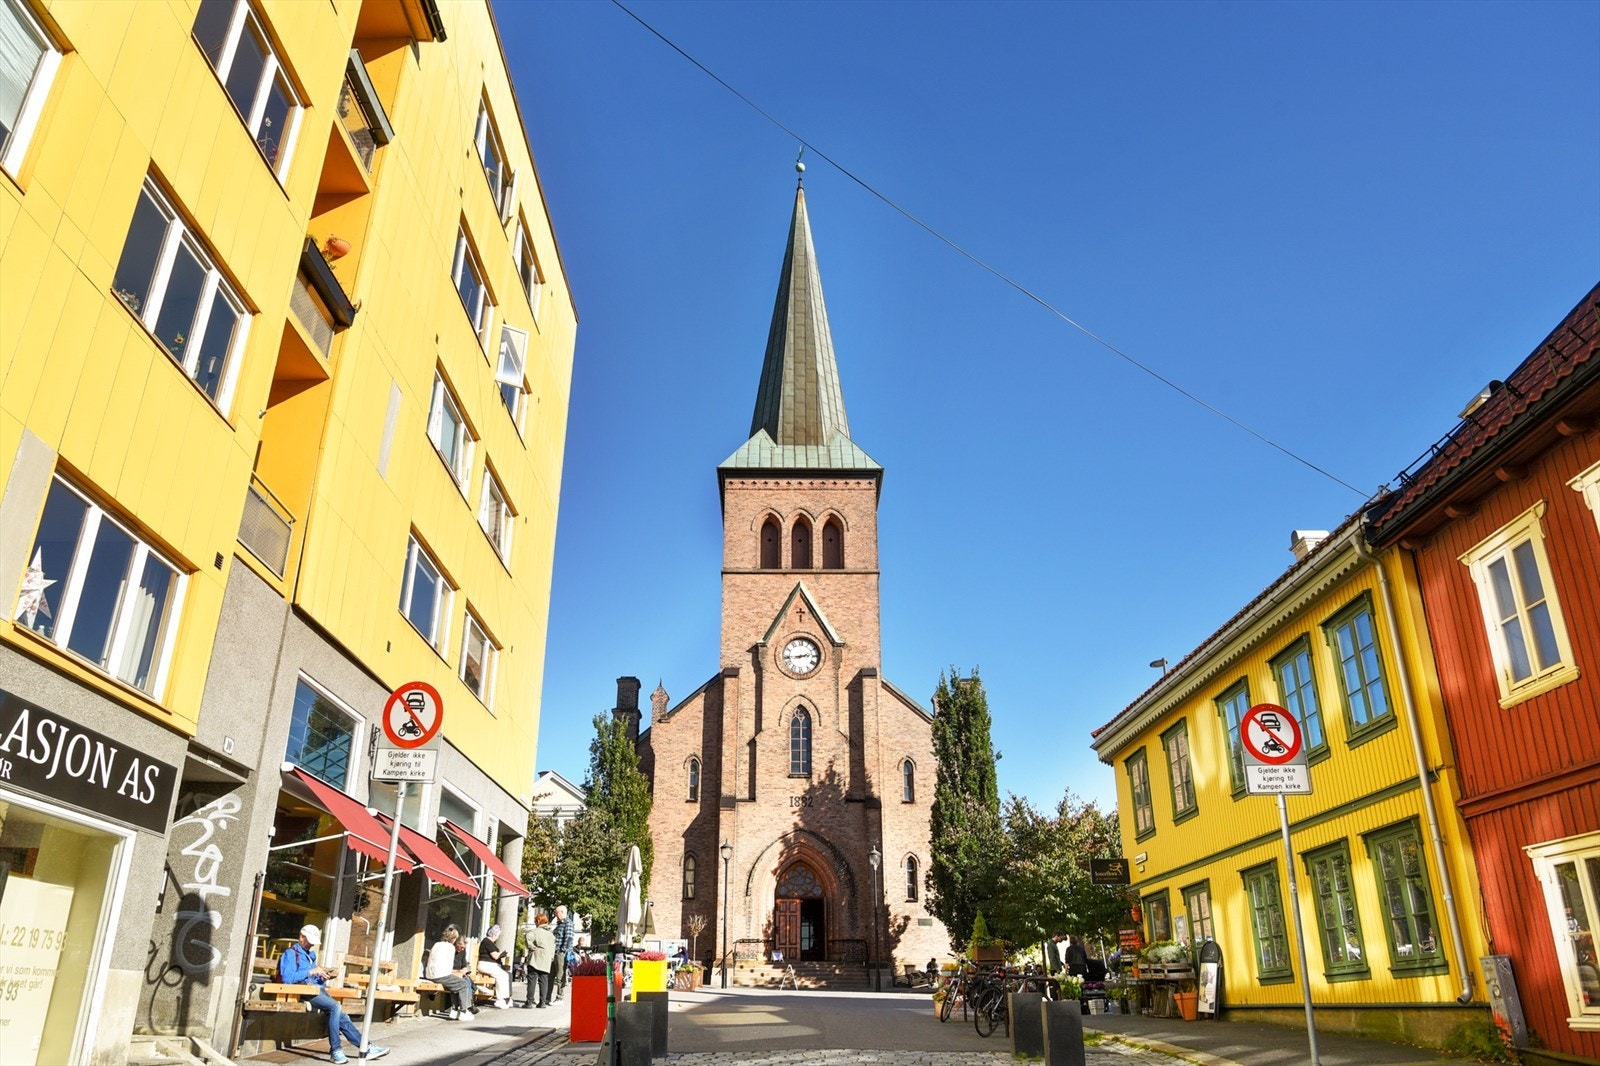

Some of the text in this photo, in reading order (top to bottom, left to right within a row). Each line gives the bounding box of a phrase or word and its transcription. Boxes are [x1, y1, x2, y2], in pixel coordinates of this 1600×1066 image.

[0, 708, 160, 805] ASJON AS
[388, 751, 409, 759] Gjelder
[390, 760, 411, 769] kjøring
[382, 769, 426, 777] Kampen kirke
[1257, 767, 1280, 775] Gjelder
[1262, 775, 1285, 783] kjøring
[789, 796, 814, 808] 1882
[11, 926, 26, 946] 22
[29, 928, 40, 948] 19
[41, 930, 54, 950] 75
[7, 963, 13, 974] vi
[15, 966, 31, 976] som
